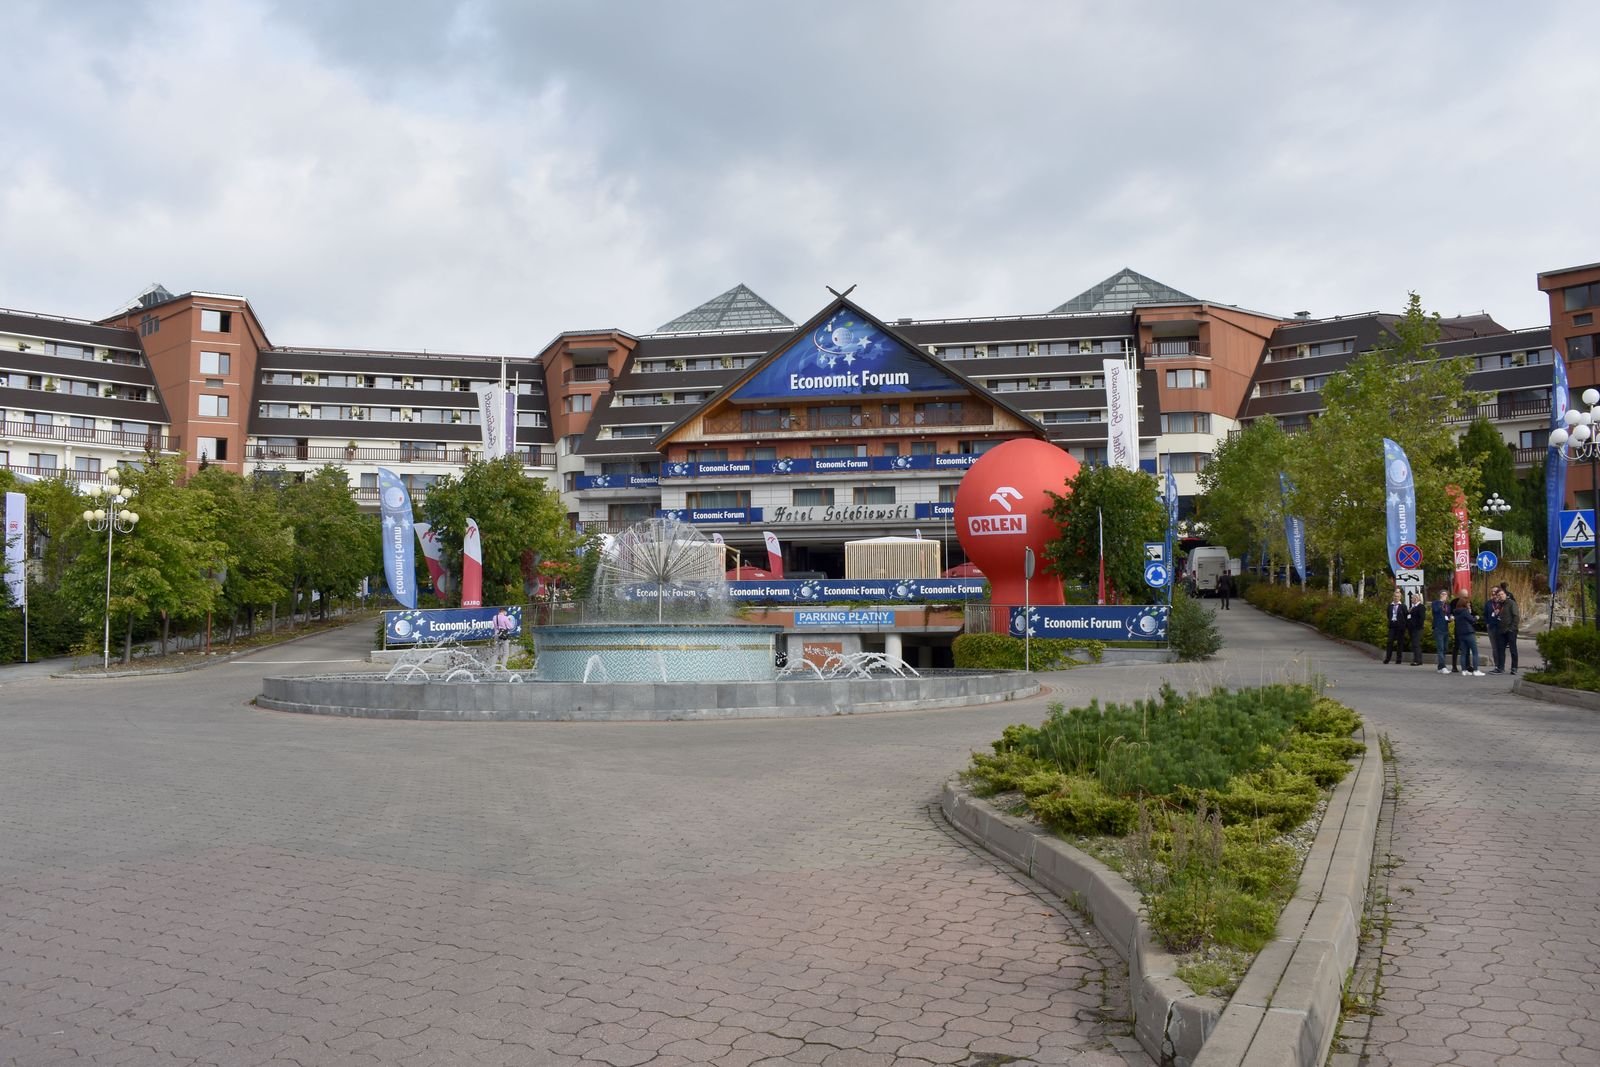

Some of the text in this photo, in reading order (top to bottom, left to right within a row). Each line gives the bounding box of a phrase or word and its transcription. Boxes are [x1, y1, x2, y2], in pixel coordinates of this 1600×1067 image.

[790, 370, 910, 390] Economic Forum
[816, 459, 868, 468] Economic Forum
[936, 456, 967, 465] Economic
[699, 463, 750, 472] Economic Forum
[630, 476, 658, 484] Economic
[934, 505, 955, 514] Econo
[693, 511, 745, 519] Economic Forum
[767, 506, 813, 523] Hotel
[971, 517, 1023, 533] ORLEN
[672, 588, 696, 597] Forum
[729, 586, 790, 596] Economic Forum
[824, 586, 885, 595] Economic Forum
[920, 584, 983, 594] Economic Forum
[799, 611, 889, 621] PARKING PŁATNY
[430, 618, 495, 632] Economic Forum
[1044, 617, 1122, 629] Economic Forum
